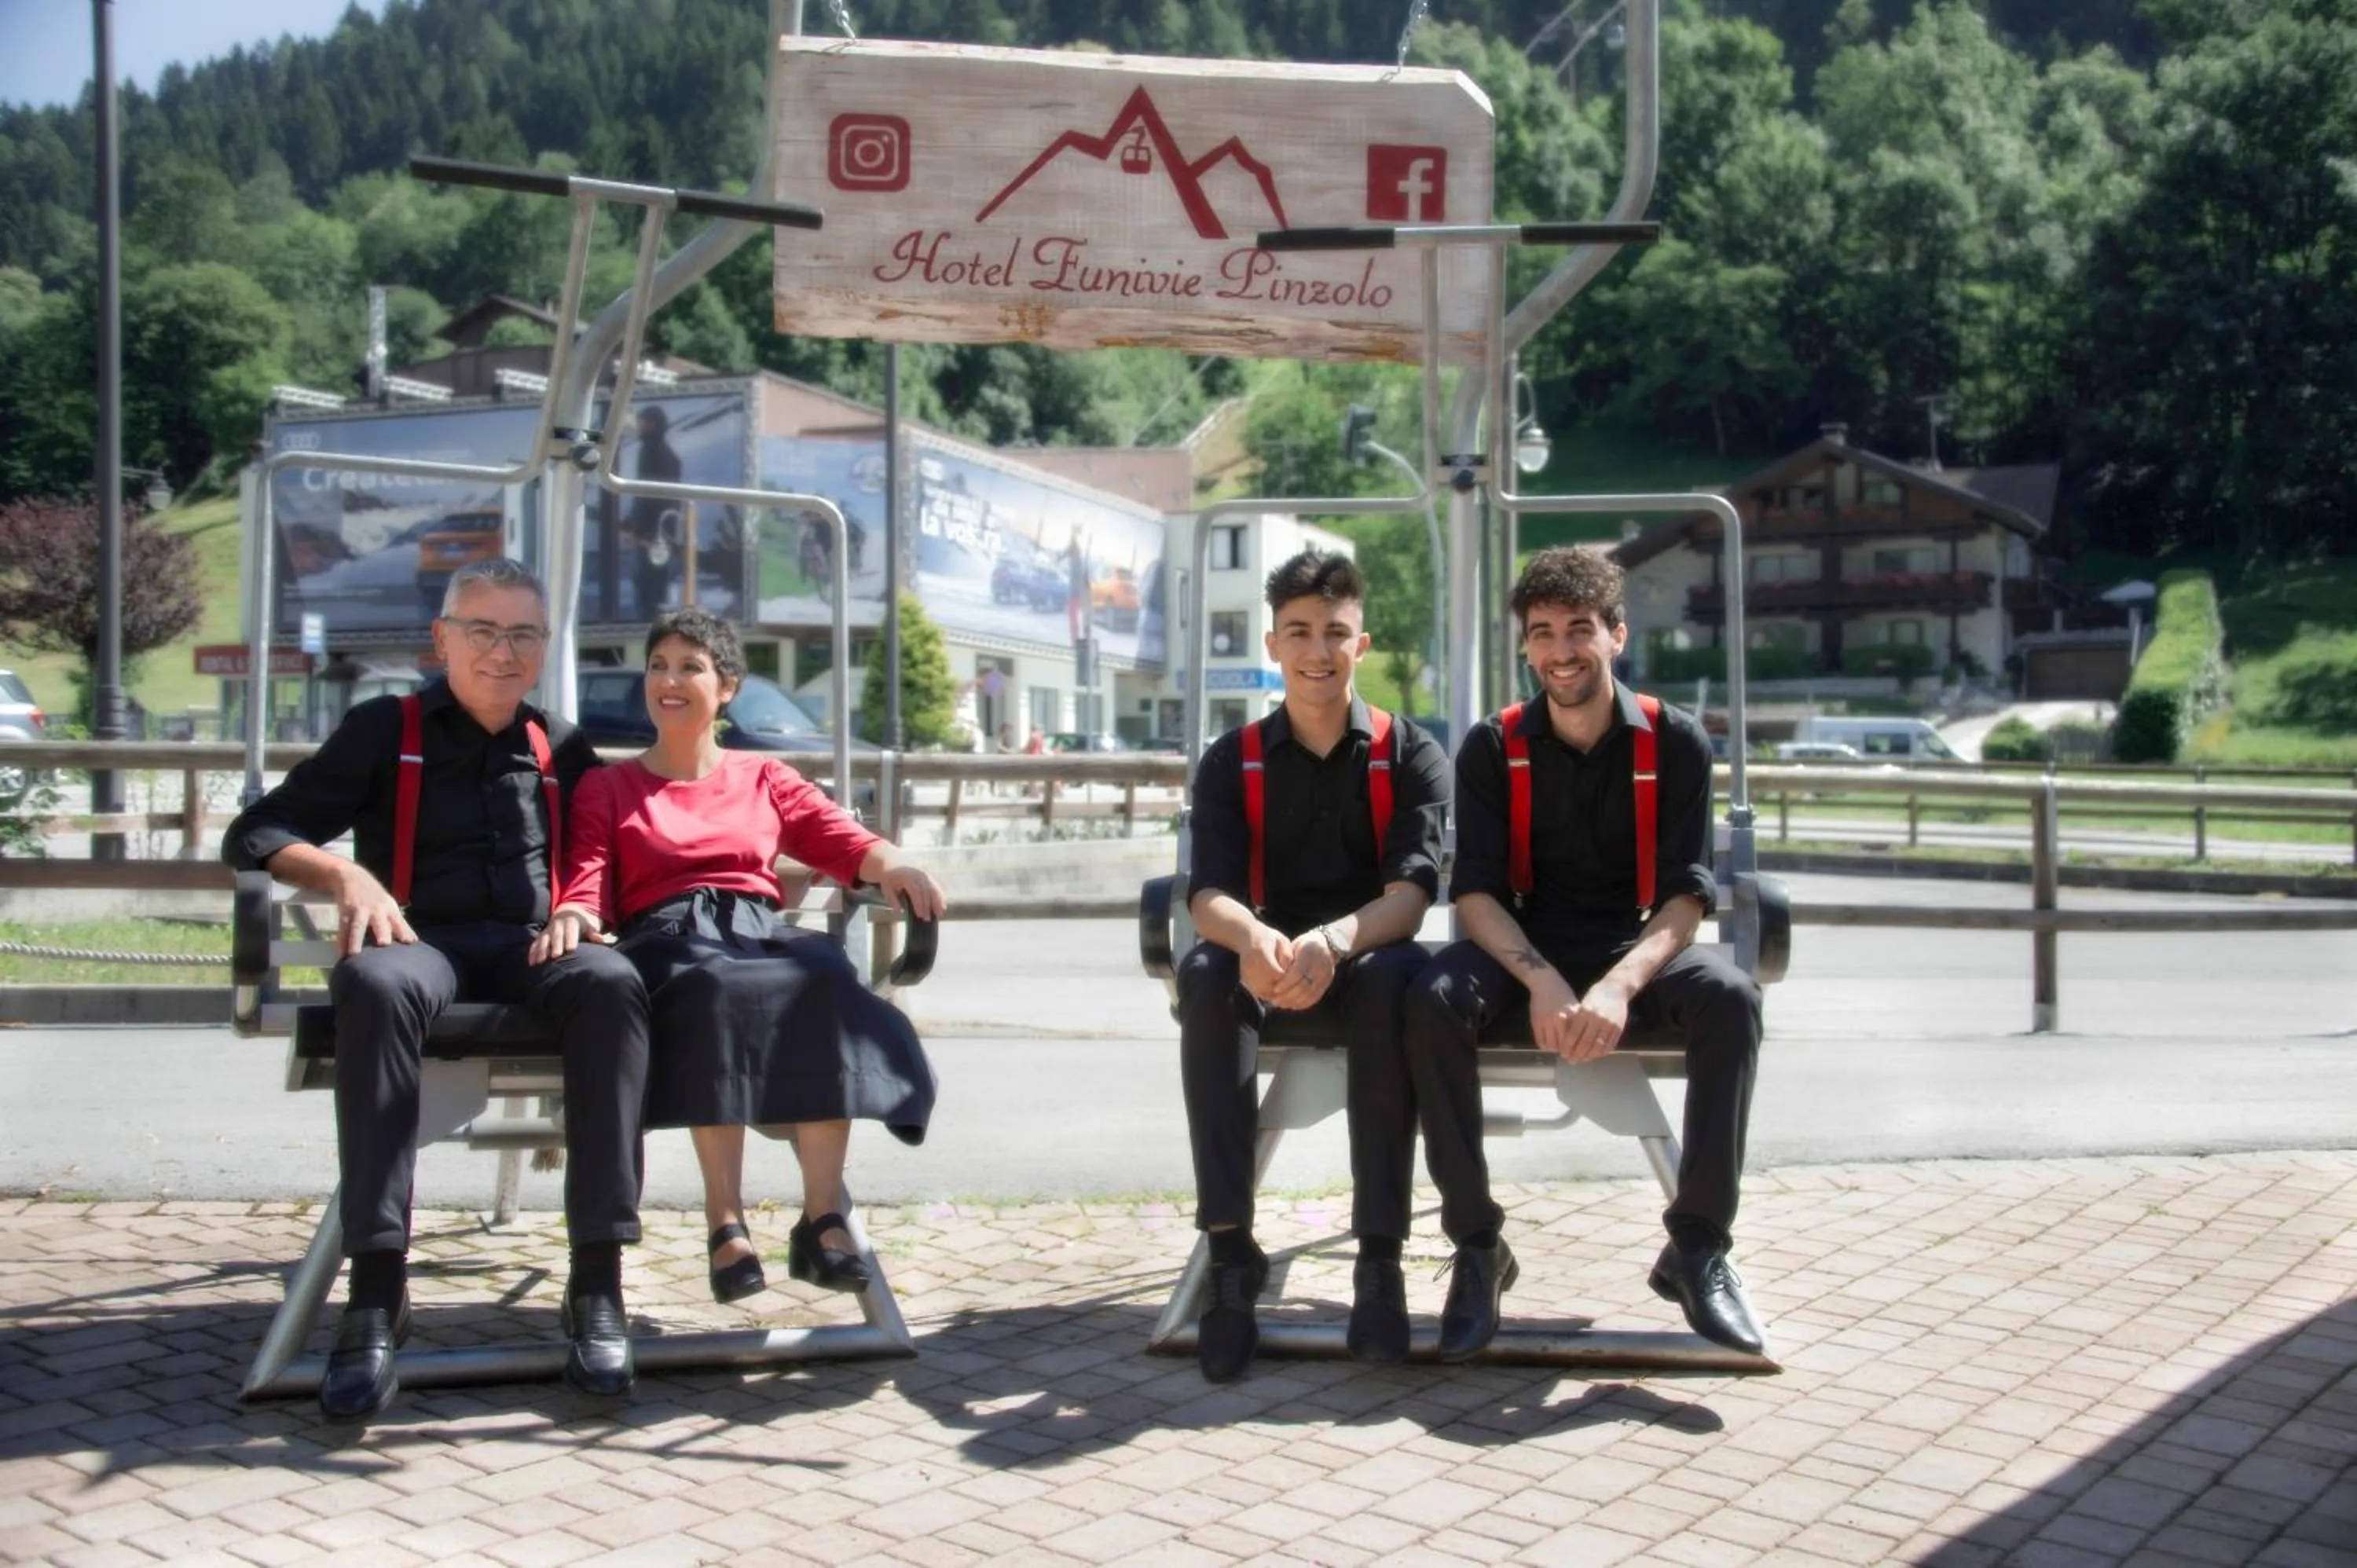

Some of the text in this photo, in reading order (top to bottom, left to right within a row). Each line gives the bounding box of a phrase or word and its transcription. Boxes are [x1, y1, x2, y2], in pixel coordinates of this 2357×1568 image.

[873, 229, 1393, 308] Hotel Funivie Pinzolo
